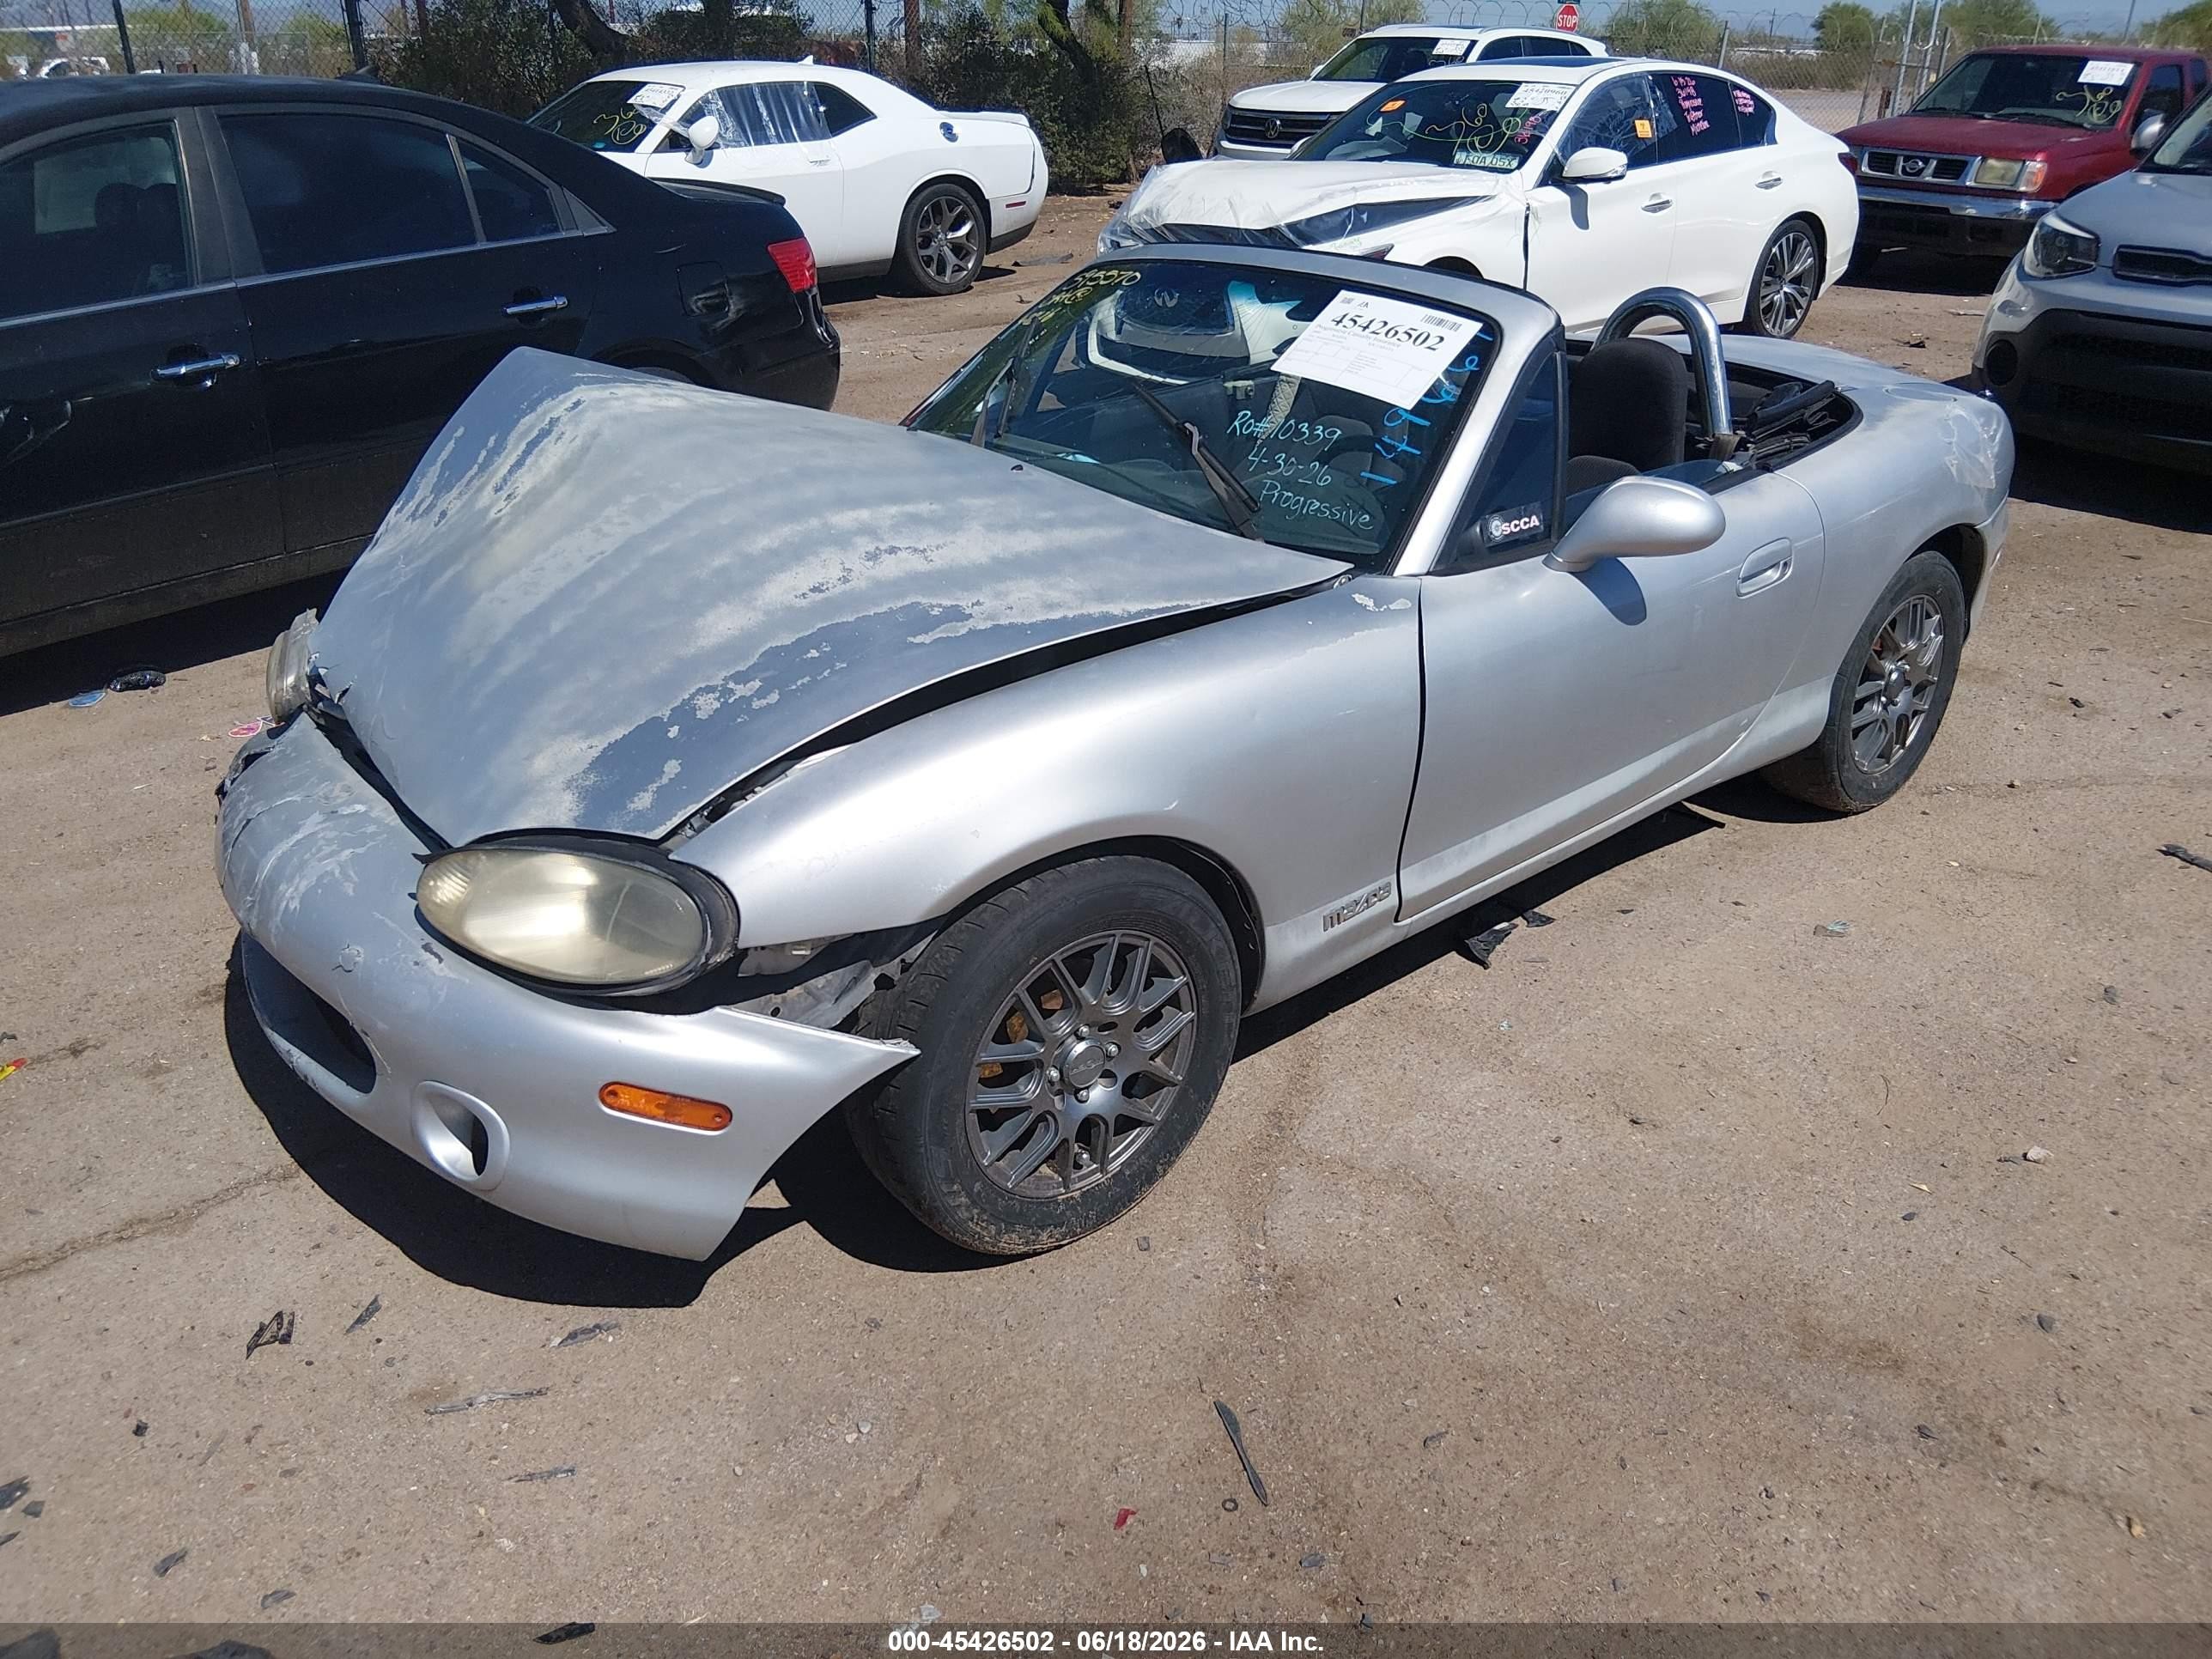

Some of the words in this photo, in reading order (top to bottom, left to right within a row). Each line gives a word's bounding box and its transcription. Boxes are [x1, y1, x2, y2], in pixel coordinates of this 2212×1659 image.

[1558, 14, 1577, 27] STOP
[1331, 313, 1445, 351] 45426502
[1259, 479, 1374, 530] Progressive
[1501, 515, 1540, 535] SCCA
